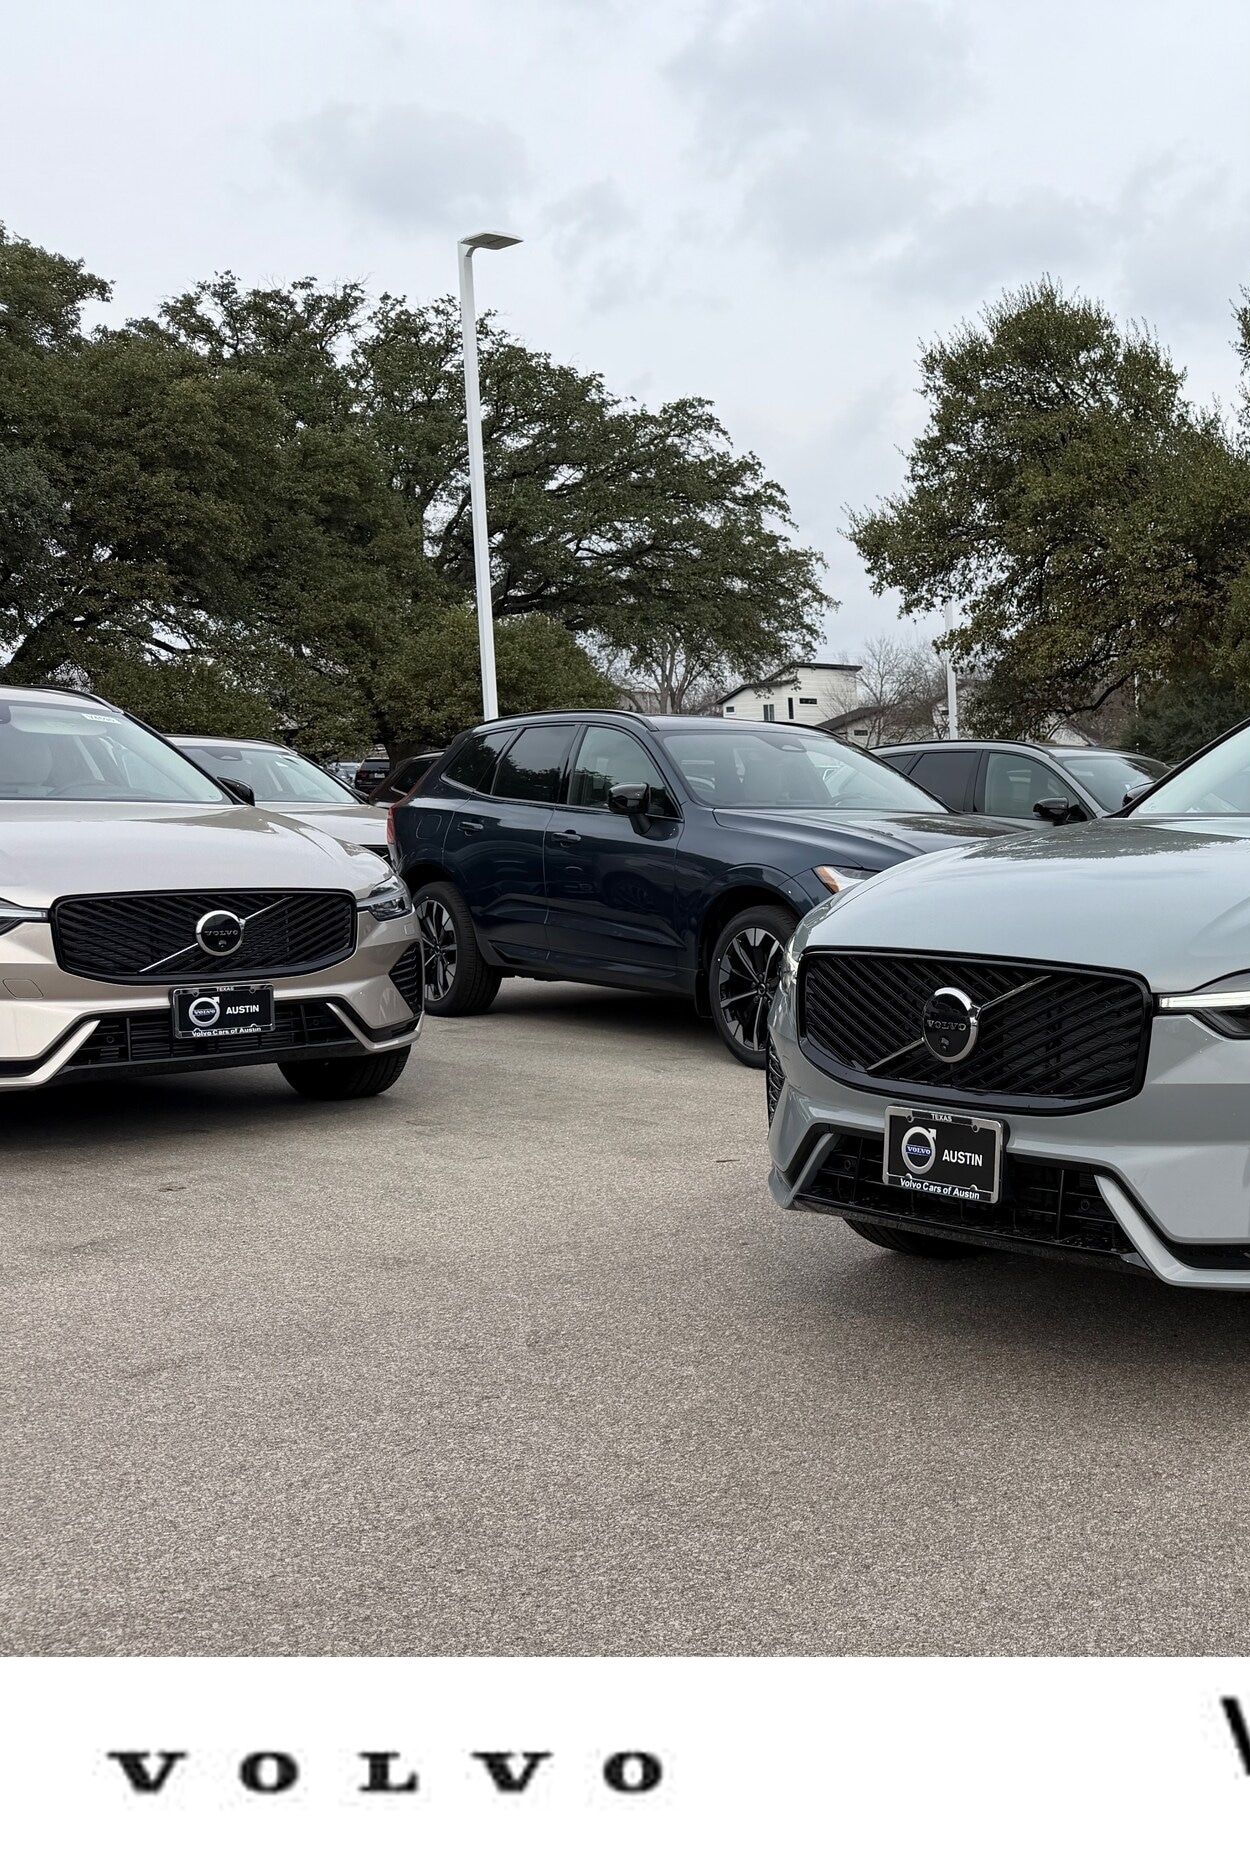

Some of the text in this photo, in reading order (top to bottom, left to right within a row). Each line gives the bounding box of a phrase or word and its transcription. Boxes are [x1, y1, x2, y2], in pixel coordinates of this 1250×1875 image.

[226, 1005, 260, 1015] AUSTIN
[927, 1019, 967, 1032] VOLVO
[931, 1113, 953, 1123] TEXAS
[907, 1145, 931, 1155] VOLVO
[942, 1149, 983, 1167] AUSTIN
[900, 1177, 980, 1200] Volvo Cars of Austin
